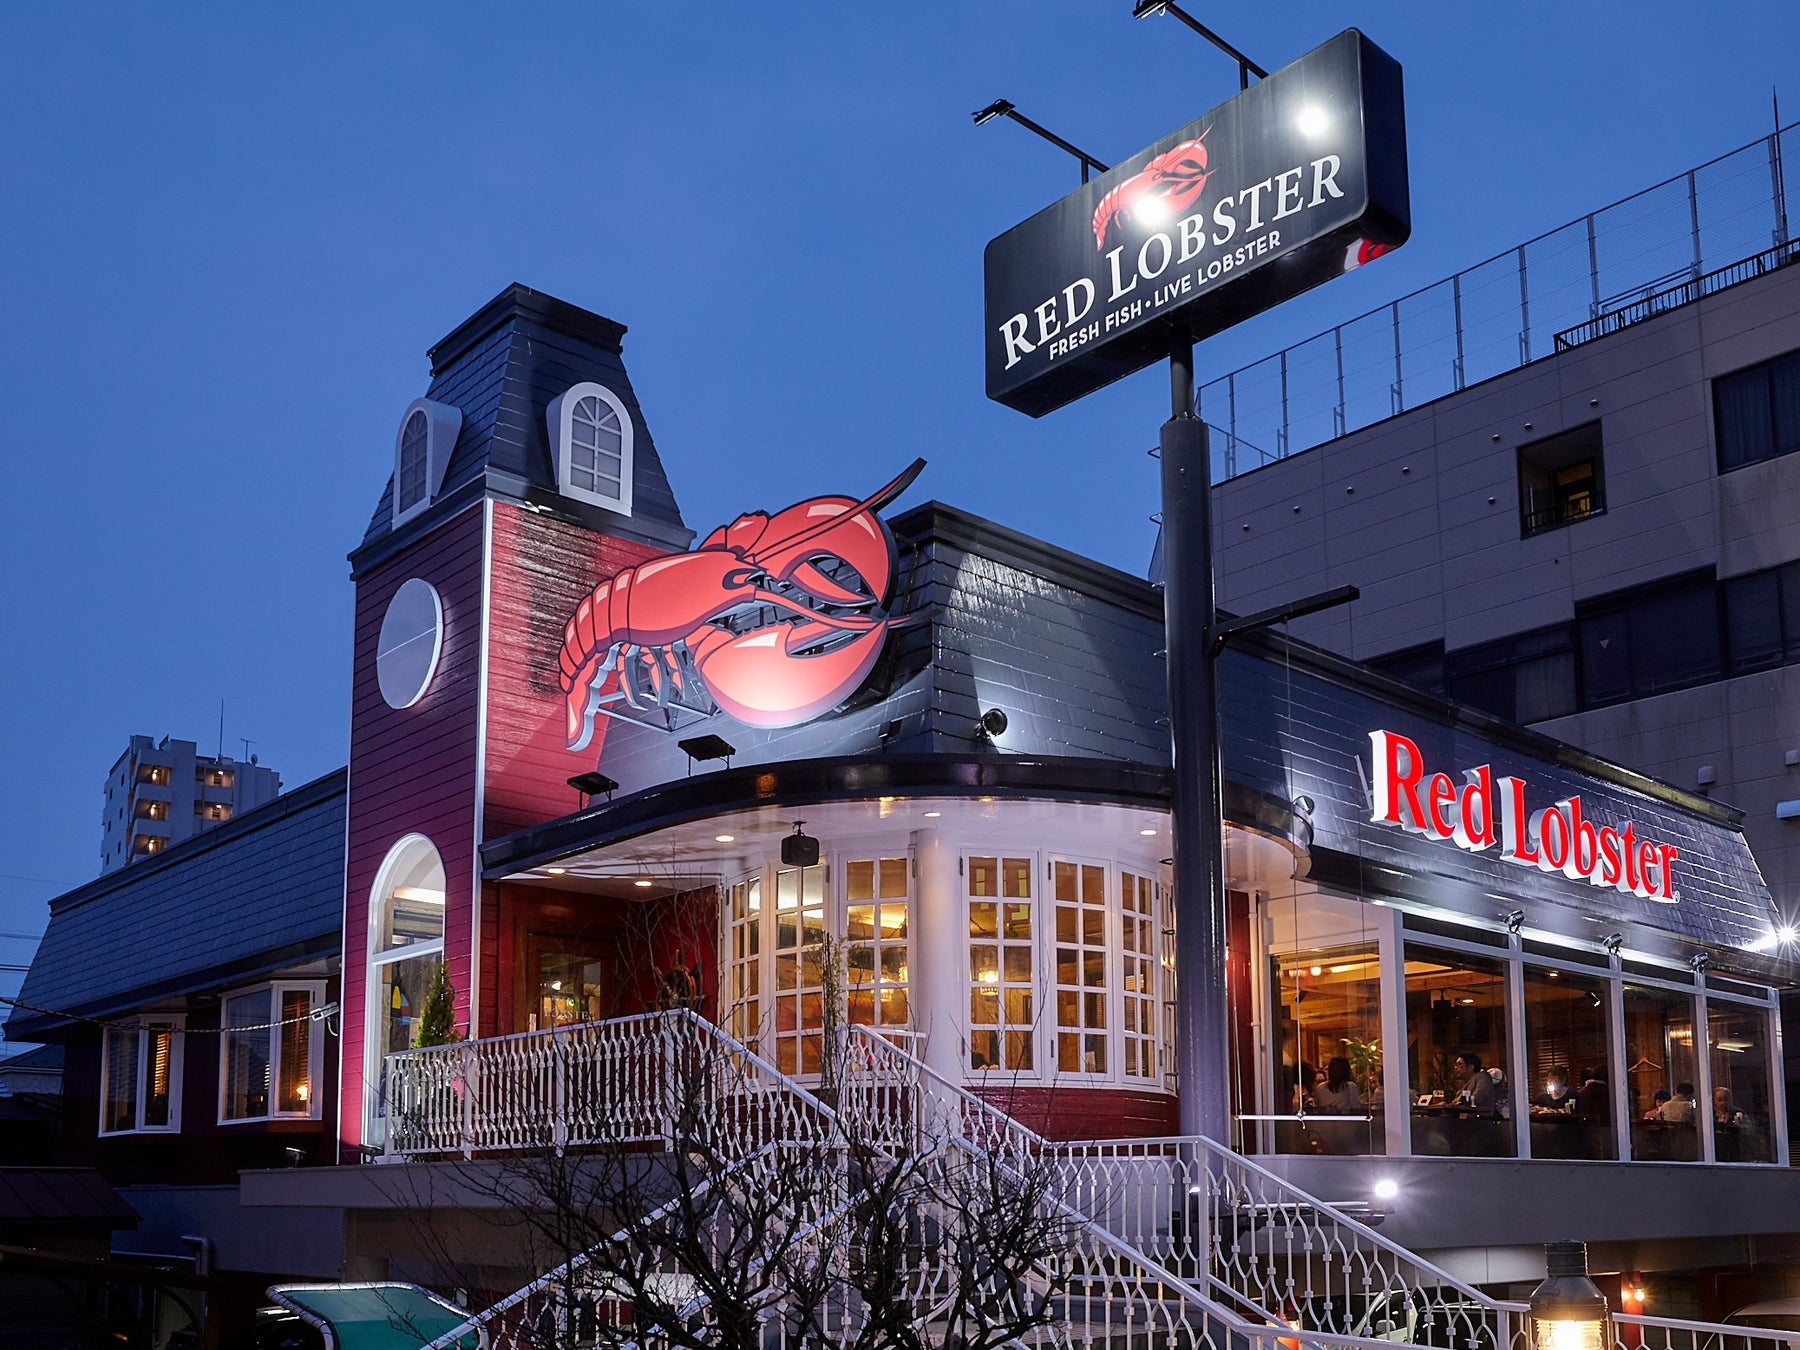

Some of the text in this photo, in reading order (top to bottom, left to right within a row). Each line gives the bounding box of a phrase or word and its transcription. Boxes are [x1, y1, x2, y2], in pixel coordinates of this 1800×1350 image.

[999, 154, 1345, 370] RED LOBSTER
[1049, 230, 1281, 361] FRESH FISH LIVE LOBSTER
[1369, 729, 1679, 903] Red Lobster
